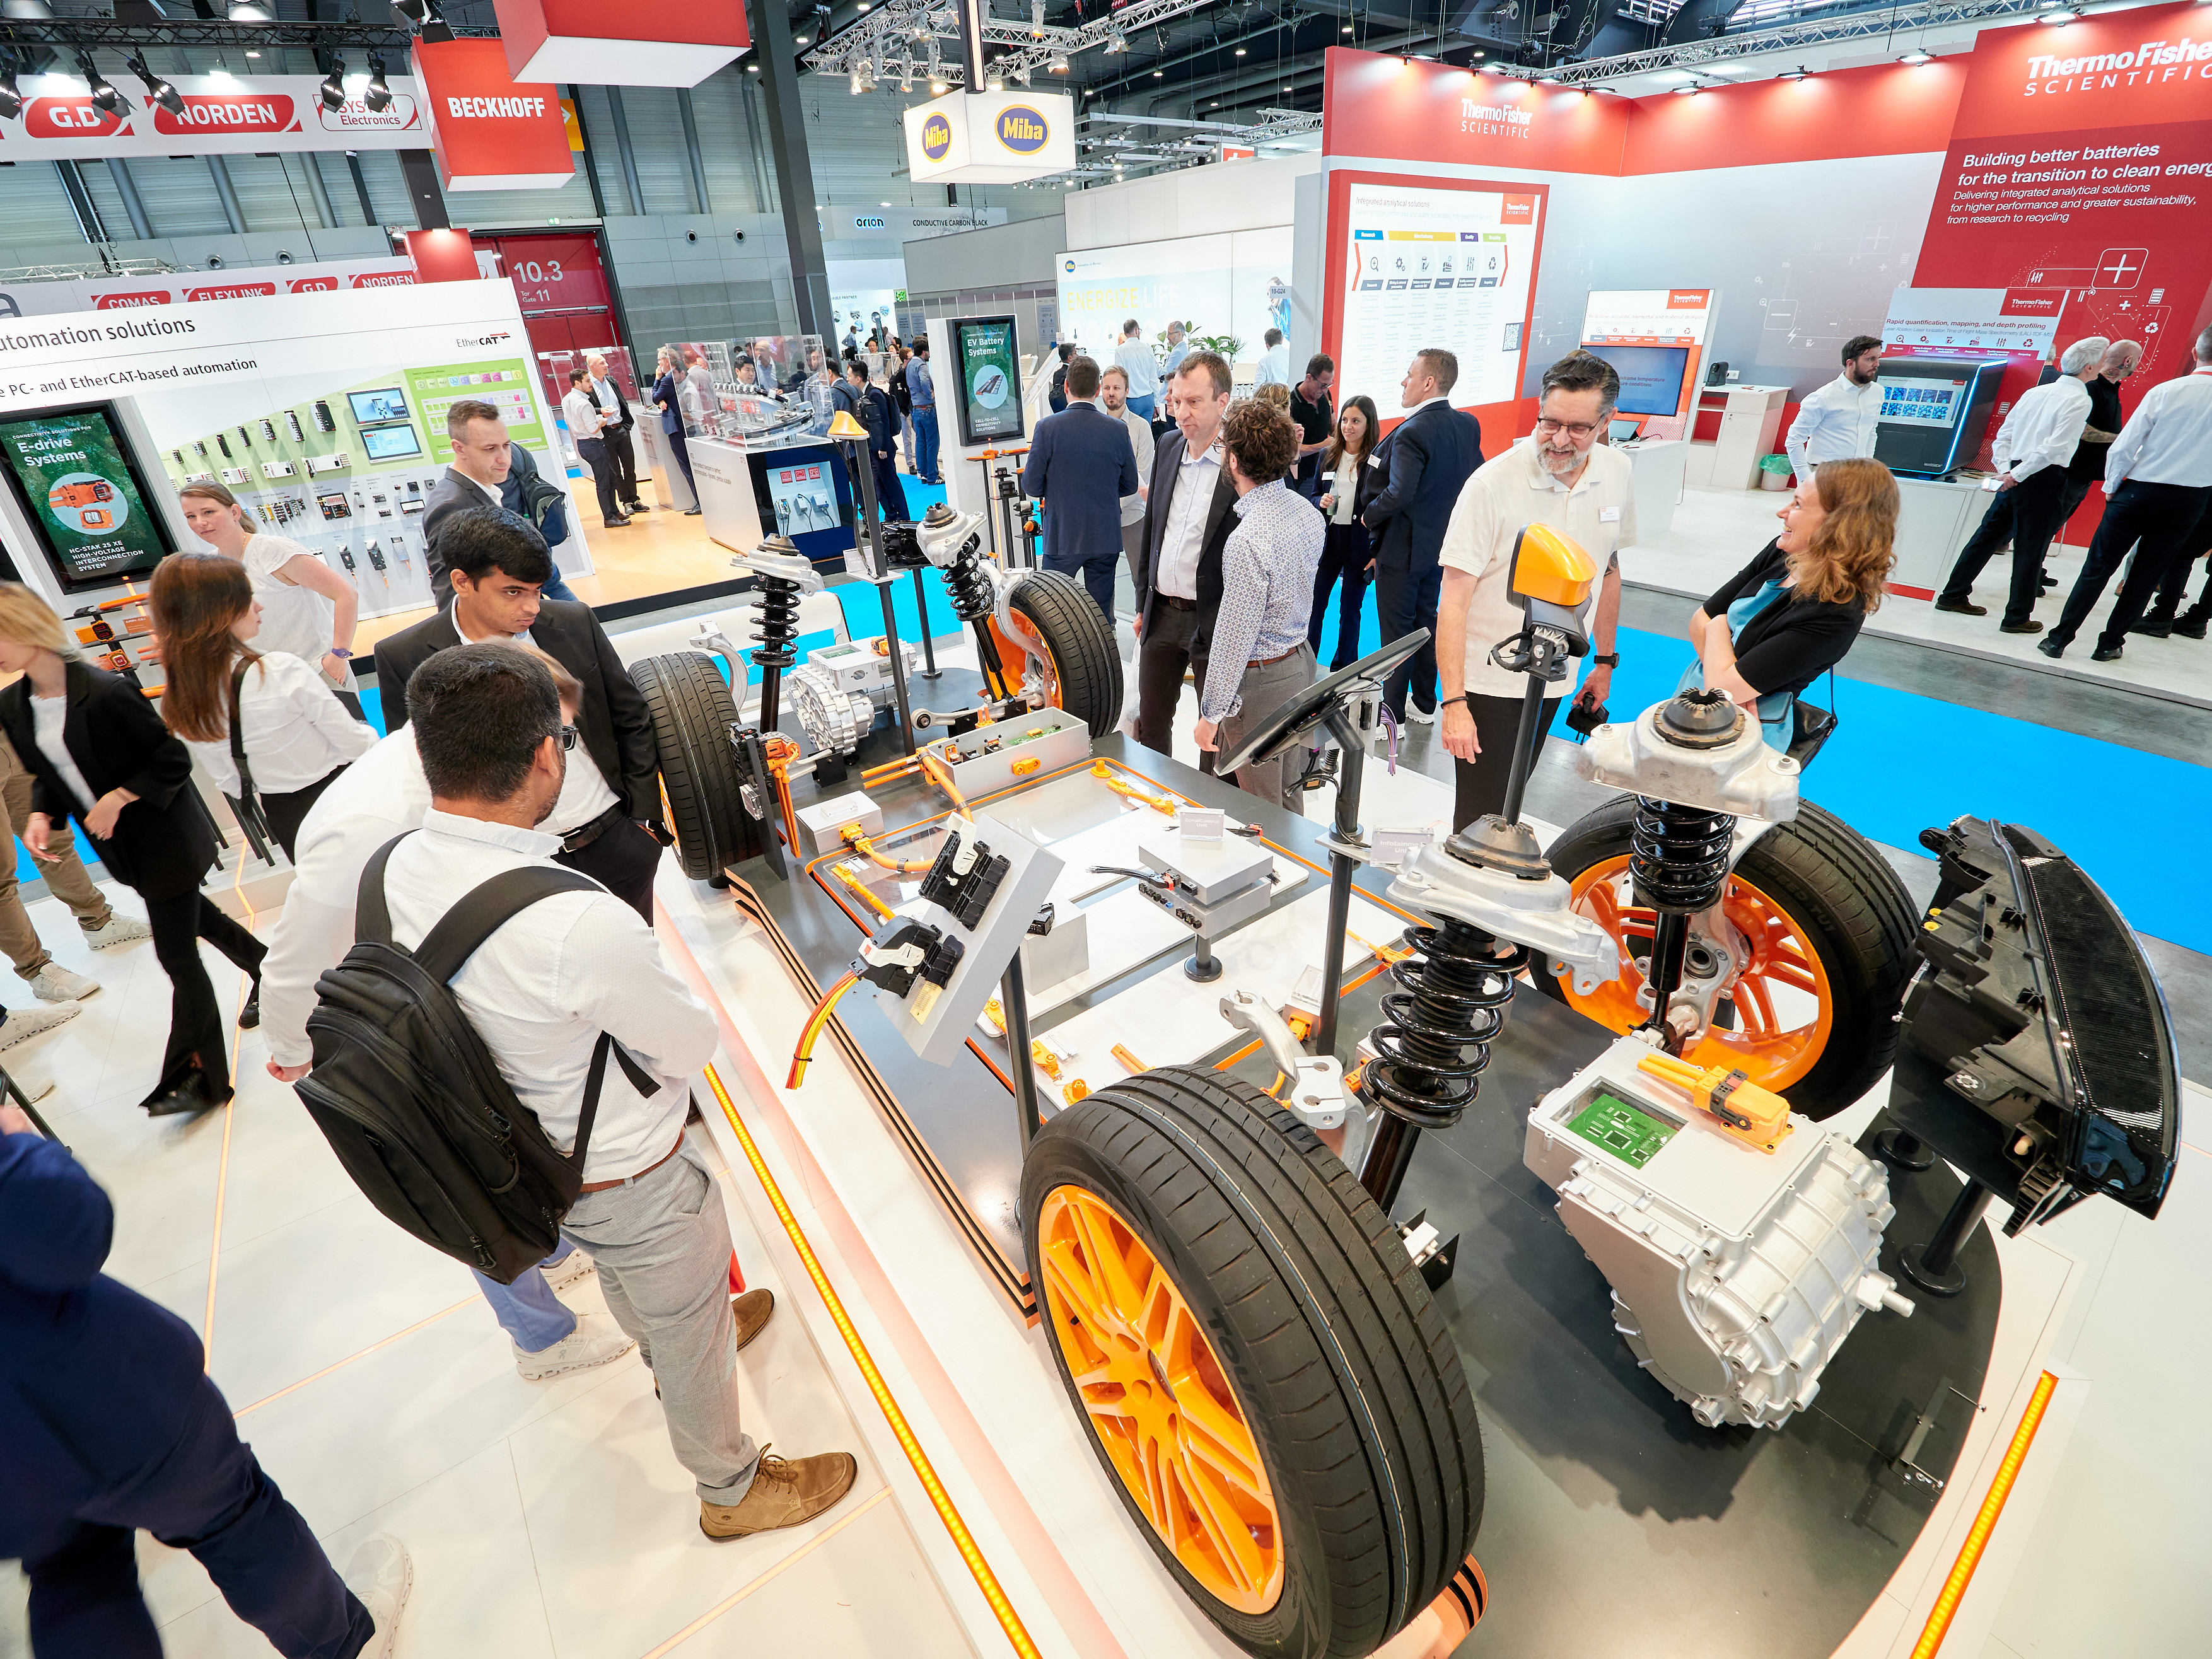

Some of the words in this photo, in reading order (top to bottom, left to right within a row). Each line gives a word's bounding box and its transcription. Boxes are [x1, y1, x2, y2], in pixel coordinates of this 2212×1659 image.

[176, 103, 277, 126] NORDEN
[447, 97, 545, 118] BECKHOFF
[341, 115, 400, 125] Electronics
[1003, 117, 1044, 140] Miba
[1461, 120, 1529, 139] SCIENTIFIC
[925, 125, 948, 150] Miba
[1962, 153, 2025, 168] Building
[2030, 148, 2080, 163] better
[2082, 143, 2160, 161] batteries
[1958, 174, 1978, 186] for
[1982, 172, 2006, 185] the
[2011, 168, 2086, 183] transition
[2091, 167, 2108, 180] to
[2112, 163, 2161, 178] clean
[2165, 161, 2212, 178] energ
[1953, 190, 1998, 201] Delivering
[2001, 187, 2049, 199] integrated
[2052, 184, 2100, 195] analytical
[2102, 183, 2150, 194] solutions
[1356, 197, 1383, 206] Integrated
[1383, 199, 1407, 207] analytical
[1408, 200, 1429, 208] solutions
[1950, 203, 1964, 212] for
[1965, 201, 1994, 213] higher
[1995, 199, 2058, 212] performance
[2061, 199, 2081, 209] and
[2083, 197, 2120, 210] greater
[2123, 194, 2197, 206] sustainability,
[856, 218, 884, 227] orion
[1947, 214, 1968, 224] from
[1969, 213, 2011, 224] research
[2013, 214, 2023, 223] to
[2025, 212, 2069, 224] recycling
[514, 260, 563, 282] 10.3
[361, 274, 414, 288] NORDEN
[536, 289, 550, 301] 11
[1067, 288, 1139, 311] ENERGIZE
[1143, 284, 1180, 308] LIFE
[108, 296, 160, 310] COMAS
[0, 326, 102, 351] utomation
[105, 318, 195, 340] solutions
[2017, 323, 2046, 331] profiling
[457, 337, 499, 347] EtherCAT
[967, 339, 977, 347] EV
[979, 337, 1004, 346] Battery
[968, 347, 997, 358] Systems
[9, 384, 34, 396] PC-
[40, 379, 67, 392] and
[71, 366, 178, 389] EtherCAT-based
[182, 359, 257, 376] automation
[13, 431, 51, 439] CONNECTIVITY
[51, 426, 80, 434] SOLUTIONS
[17, 438, 73, 453] E-drive
[525, 444, 549, 452] utomation
[24, 450, 87, 467] Systems
[69, 544, 102, 554] HC-STAK
[72, 546, 126, 560] HIGH-VOLTAGE
[75, 549, 144, 566] INTERCONNECTION
[78, 562, 107, 572] SYSTEM
[1754, 858, 1808, 901] SPEED
